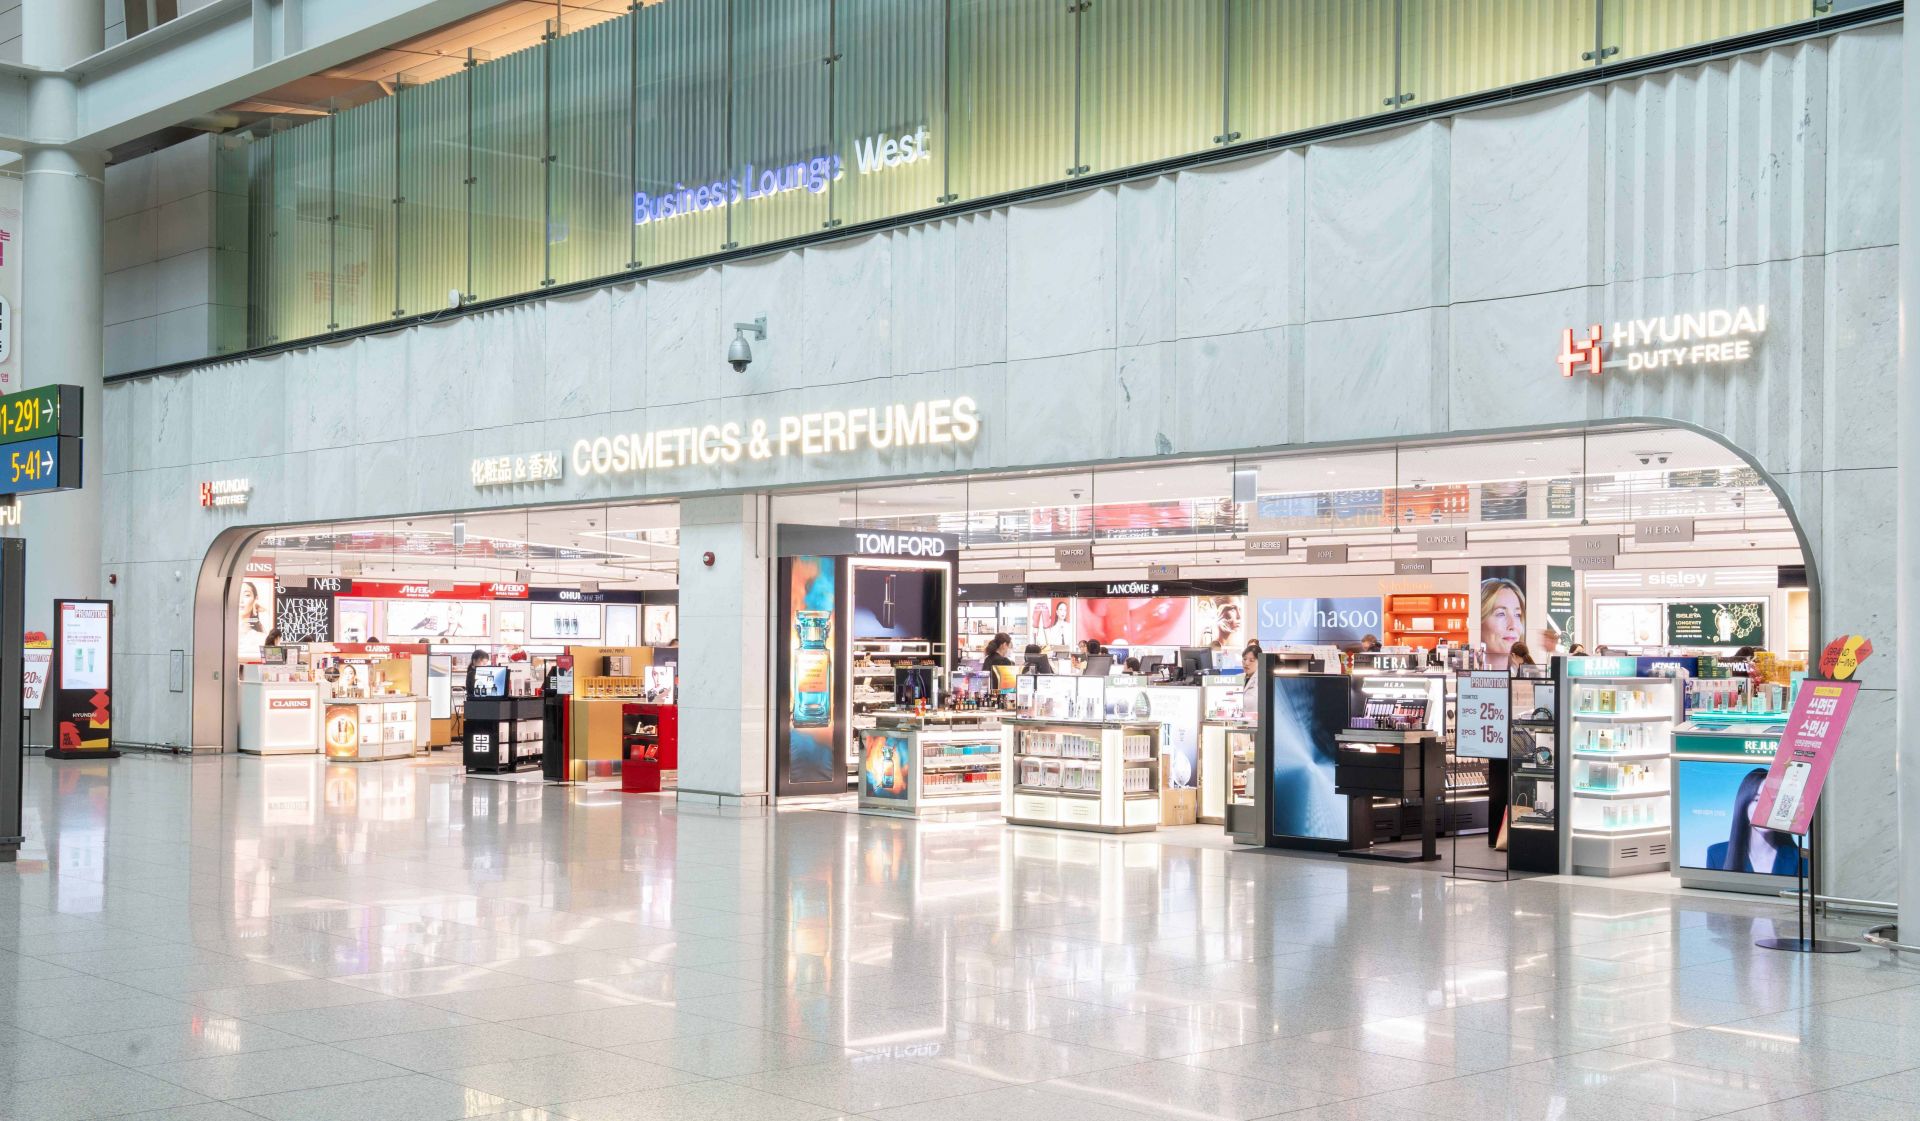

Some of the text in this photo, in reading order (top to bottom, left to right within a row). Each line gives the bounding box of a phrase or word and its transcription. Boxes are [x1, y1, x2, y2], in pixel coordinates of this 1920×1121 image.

[634, 125, 930, 225] Business Lounge West
[1612, 304, 1767, 347] HYUNDAI
[1628, 340, 1752, 371] DUTY FREE
[0, 397, 39, 435] 1-291
[572, 396, 980, 475] COSMETICS & PERFUMES
[11, 450, 41, 482] 5-41
[470, 452, 559, 485] 化粧品 & 香水
[211, 478, 248, 493] HYUNDAI
[215, 494, 248, 505] DUTY FREE
[1645, 525, 1681, 535] HERA
[856, 533, 945, 557] TOM FORD
[314, 578, 341, 591] NARS
[489, 583, 525, 592] SHISEIDO
[1648, 571, 1707, 587] sisley
[560, 591, 581, 600] OHUI
[1106, 582, 1149, 594] LANCÔME
[1261, 601, 1378, 628] Sulwhasoo
[1373, 656, 1407, 669] HERA
[1471, 677, 1509, 688] PROMOTION
[1480, 702, 1504, 720] 25%
[1480, 725, 1504, 743] 15%
[1744, 740, 1778, 750] REJUR
